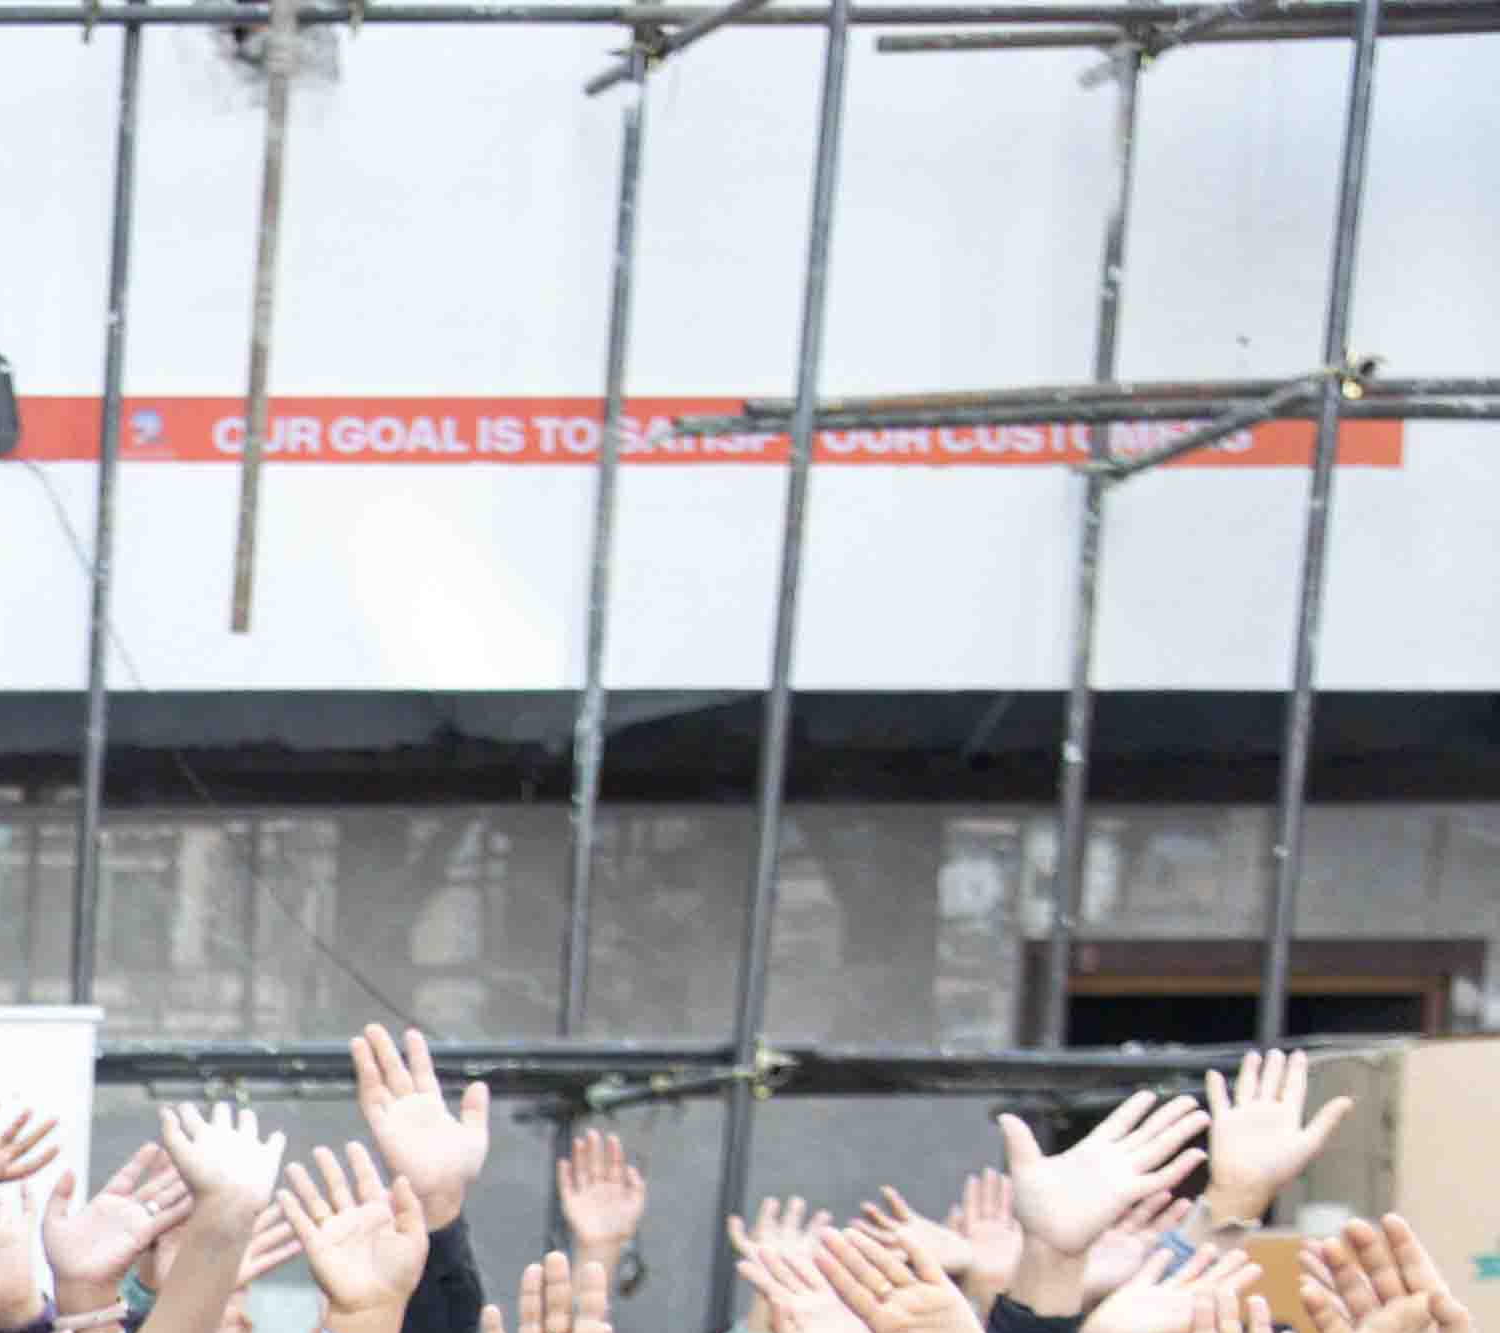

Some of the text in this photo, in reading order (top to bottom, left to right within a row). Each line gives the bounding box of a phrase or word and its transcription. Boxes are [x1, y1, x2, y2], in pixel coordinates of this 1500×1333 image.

[328, 416, 470, 454] GOAL
[476, 416, 526, 454] IS
[531, 416, 602, 453] TO
